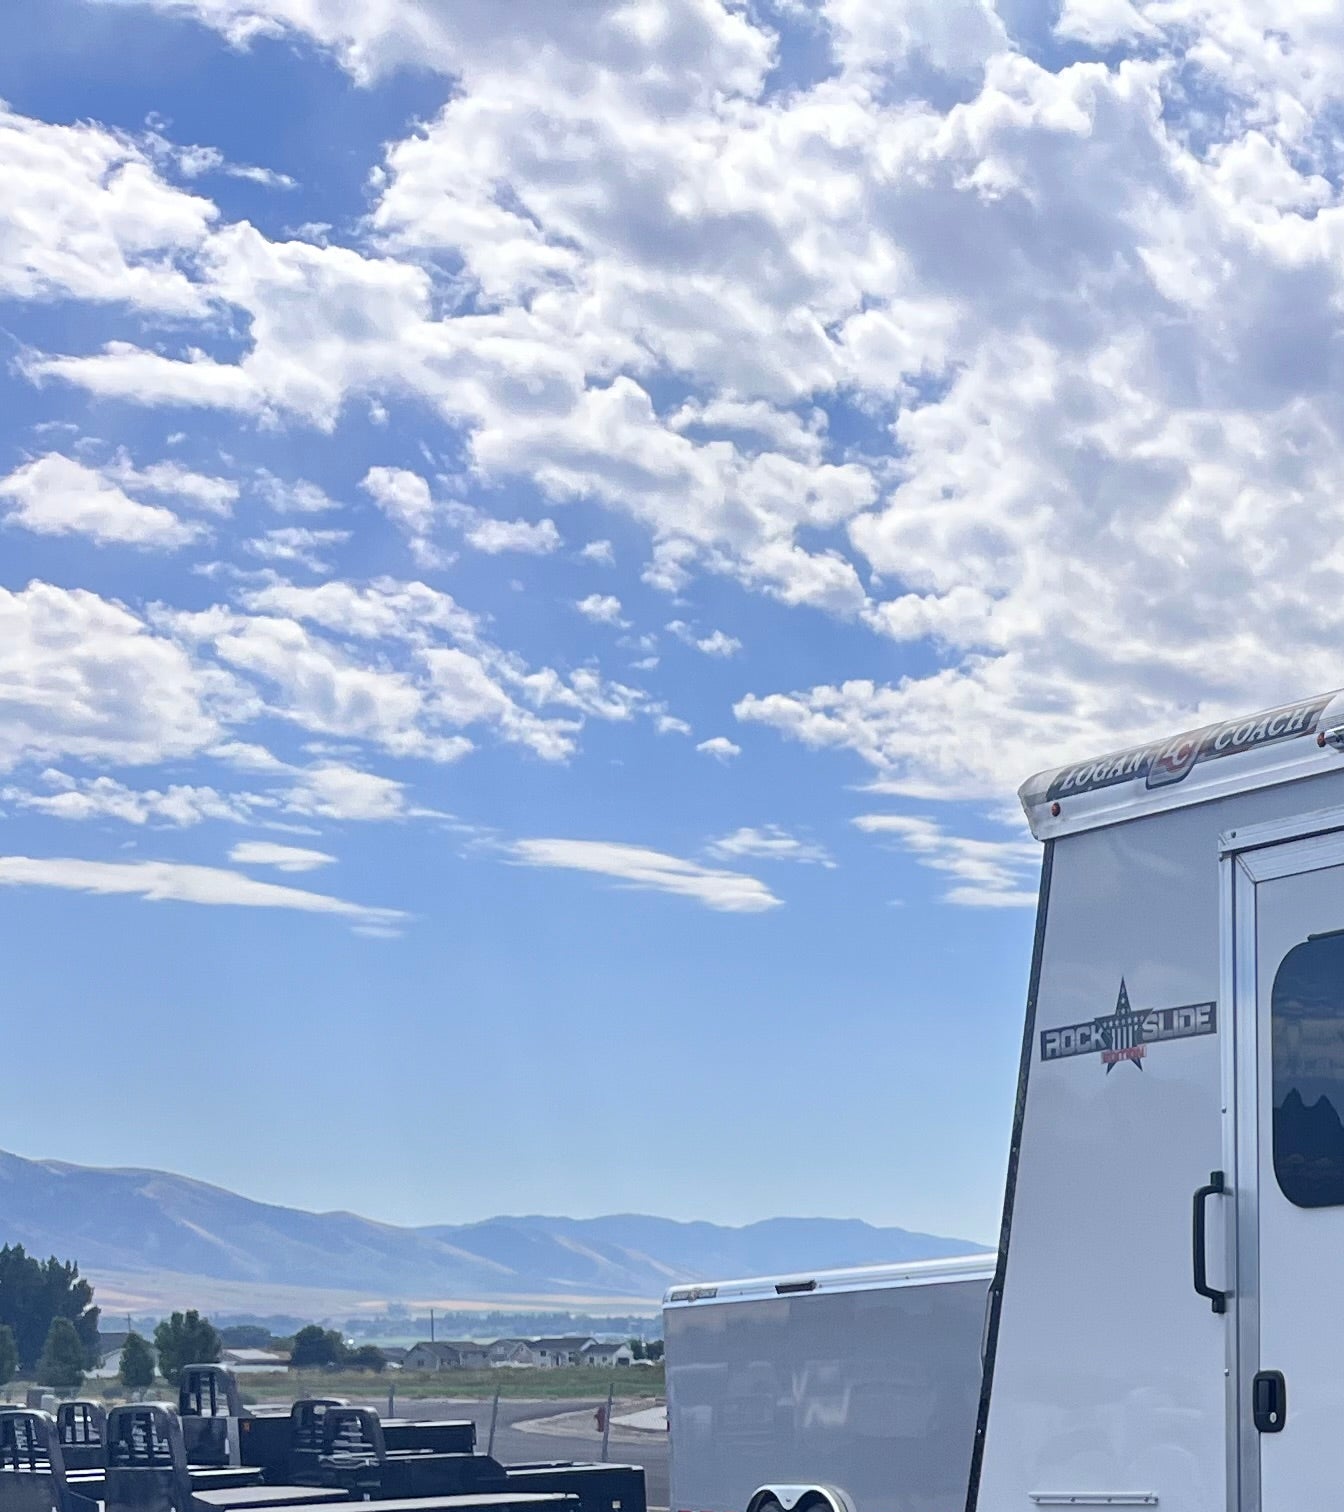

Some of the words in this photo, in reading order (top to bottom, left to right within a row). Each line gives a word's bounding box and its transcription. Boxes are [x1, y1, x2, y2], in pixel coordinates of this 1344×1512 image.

[1059, 752, 1147, 790] LOGAN
[1214, 708, 1311, 750] COACH
[1045, 1024, 1107, 1059] ROCK
[1142, 1004, 1211, 1042] SLIDE
